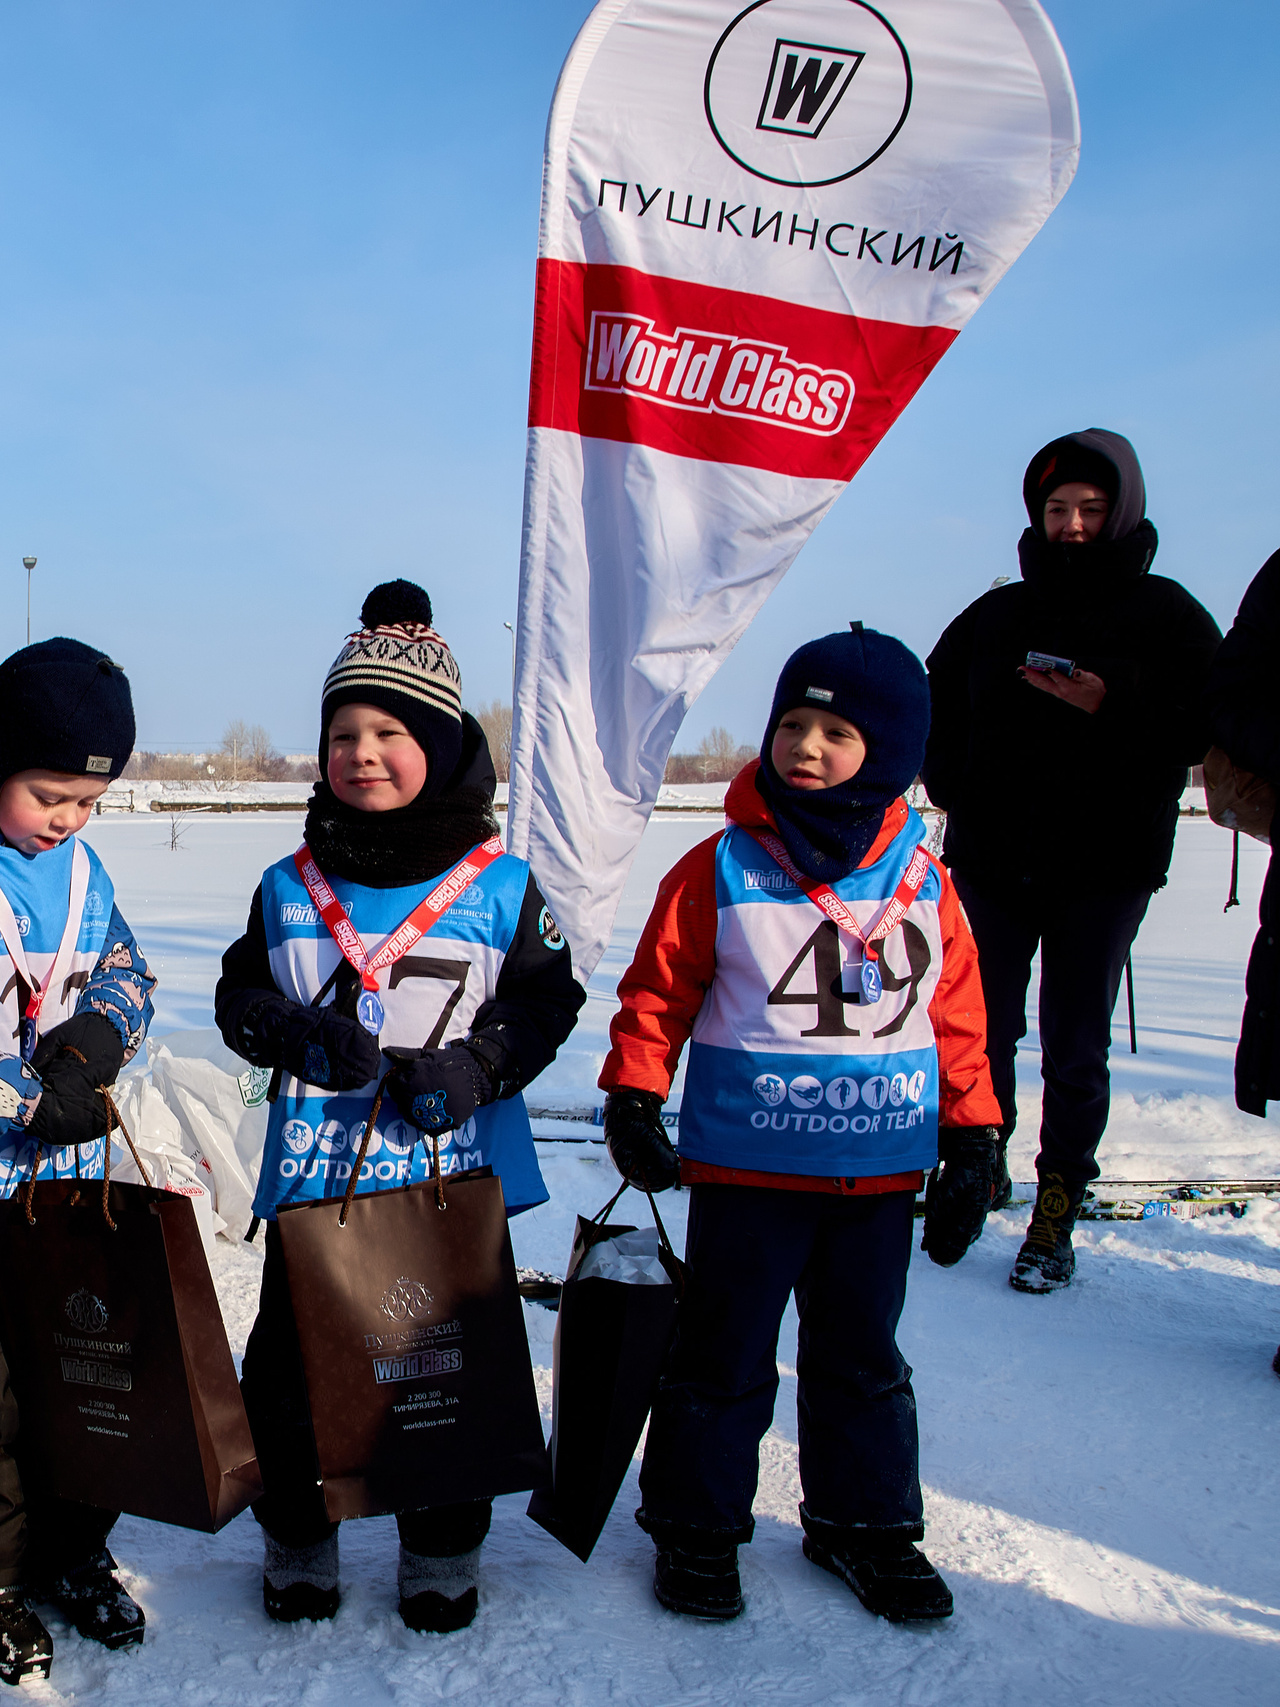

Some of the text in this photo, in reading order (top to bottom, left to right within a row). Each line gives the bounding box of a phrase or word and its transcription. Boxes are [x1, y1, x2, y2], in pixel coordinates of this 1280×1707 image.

[770, 53, 846, 126] W
[597, 178, 966, 276] ПУШКИНСКИЙ
[596, 321, 844, 426] World Class
[429, 864, 476, 910] World Class
[747, 872, 783, 889] World
[311, 884, 333, 908] World
[821, 895, 846, 919] Class
[444, 908, 493, 920] ушкински
[337, 921, 357, 946] Class
[390, 923, 418, 956] World
[767, 918, 932, 1039] 49
[868, 968, 876, 990] 2
[366, 999, 373, 1021] 1
[24, 1027, 32, 1049] 3
[750, 1105, 924, 1134] OUTDOOR TEAM
[279, 1150, 483, 1180] OUTDOOR TEAM
[53, 1332, 132, 1354] Пушкинский
[364, 1319, 463, 1350] Пушкинский
[64, 1360, 130, 1388] World Class
[376, 1352, 459, 1380] World Class
[414, 1392, 427, 1401] 200
[429, 1390, 441, 1399] 300
